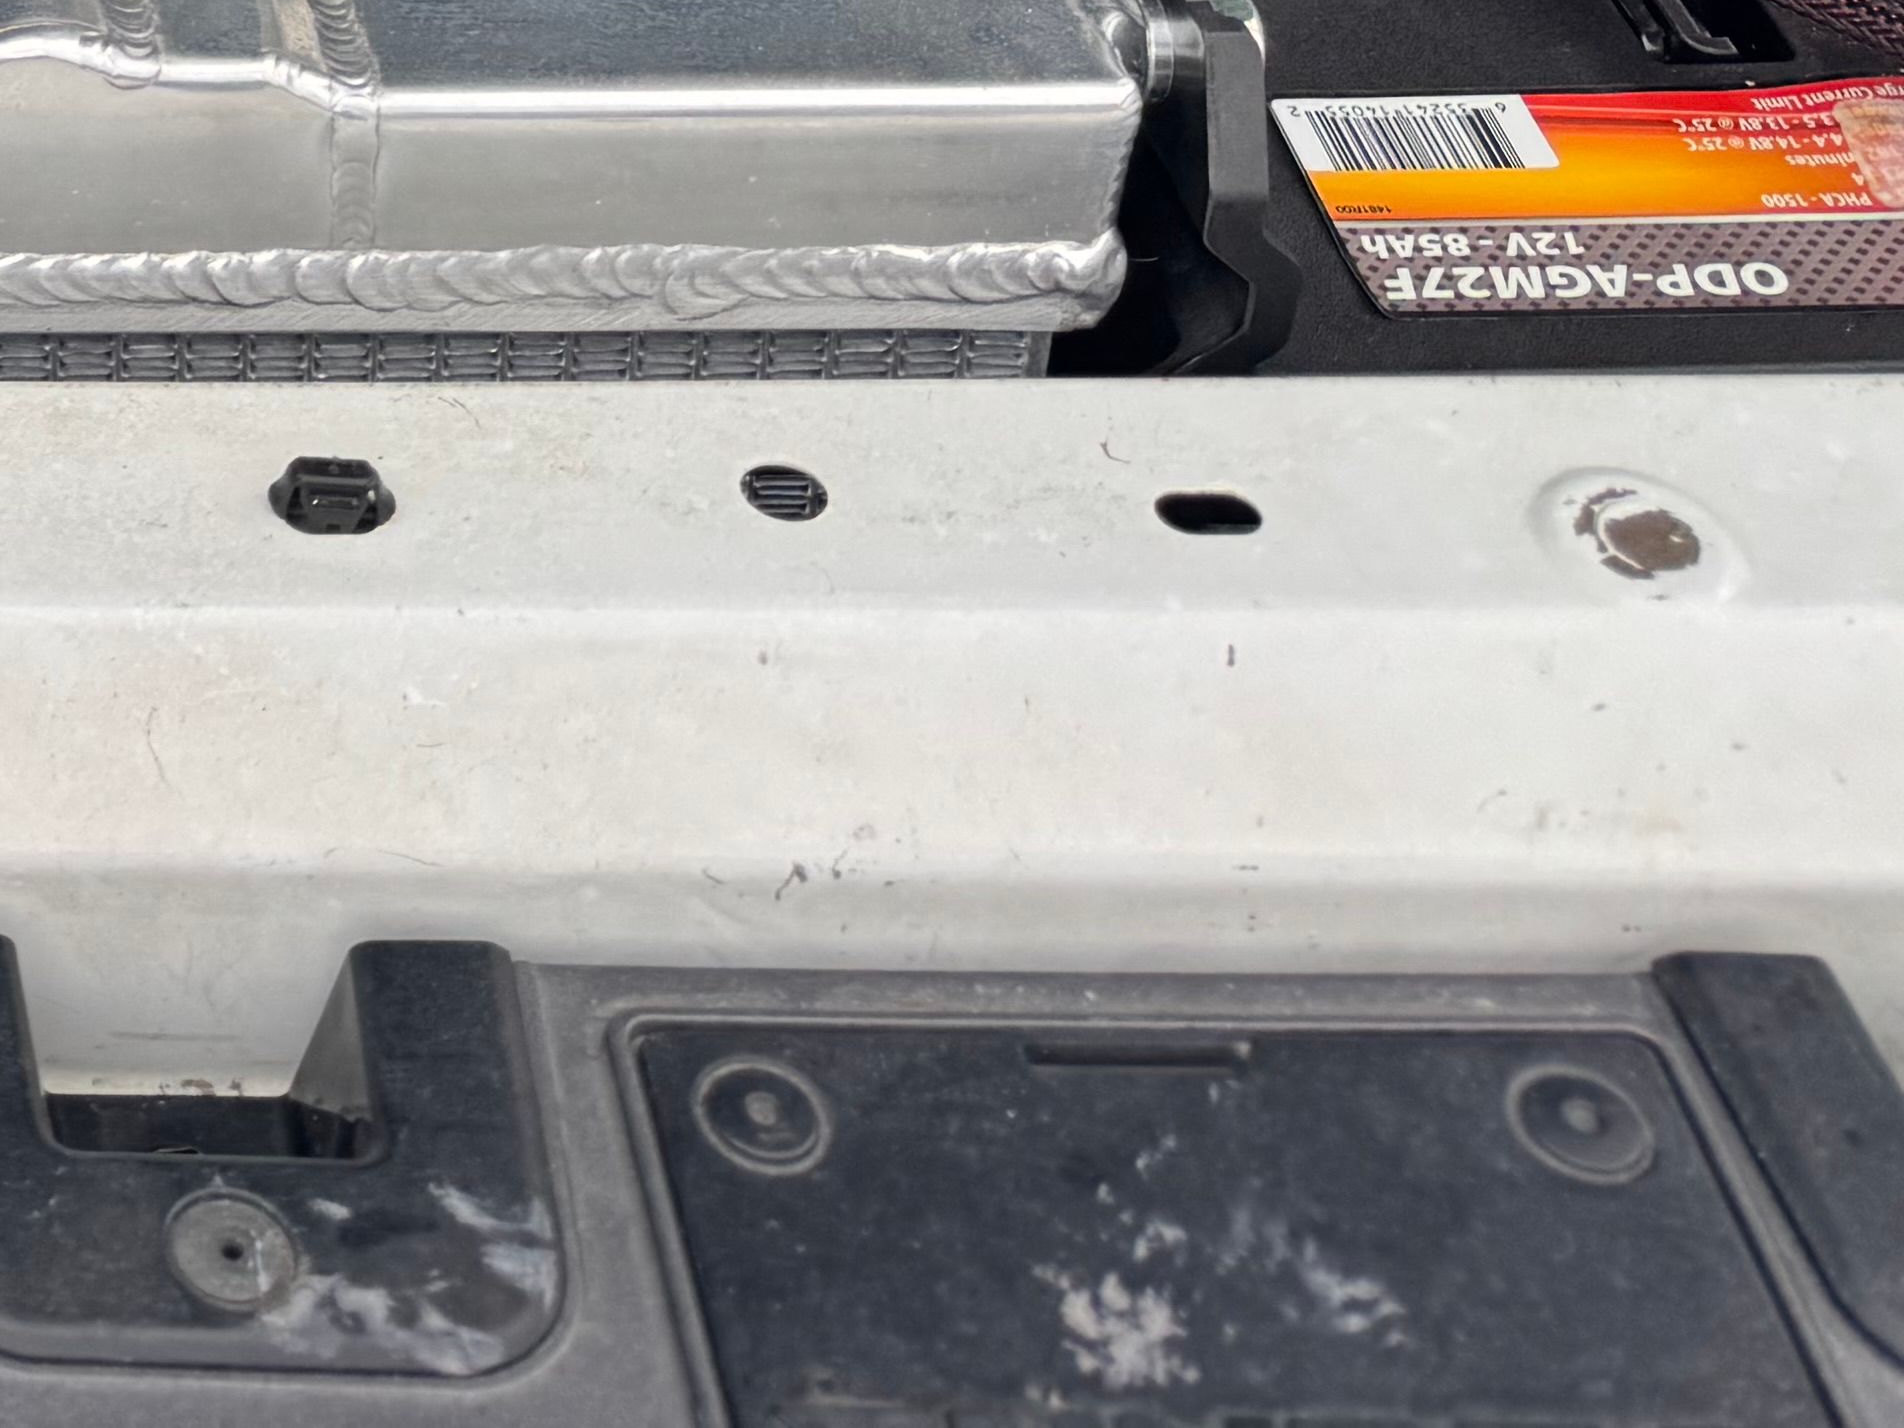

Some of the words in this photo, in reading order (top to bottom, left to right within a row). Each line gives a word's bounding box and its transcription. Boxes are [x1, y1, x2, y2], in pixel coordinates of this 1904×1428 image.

[1750, 96, 1802, 112] Limit
[1801, 86, 1873, 108] Current
[1287, 106, 1299, 117] 2
[1495, 102, 1505, 113] 6
[1717, 117, 1734, 130] @
[1738, 115, 1789, 131] 13.8V
[1802, 112, 1834, 129] 3.5
[1728, 135, 1744, 149] @
[1749, 135, 1800, 151] 14.8V
[1810, 132, 1844, 148] 4.4
[1760, 192, 1809, 208] 1500
[1819, 191, 1873, 208] PHCA
[1361, 232, 1467, 260] 85Ah
[1506, 230, 1585, 256] 12V
[1383, 259, 1789, 300] ODP-AGM27F
